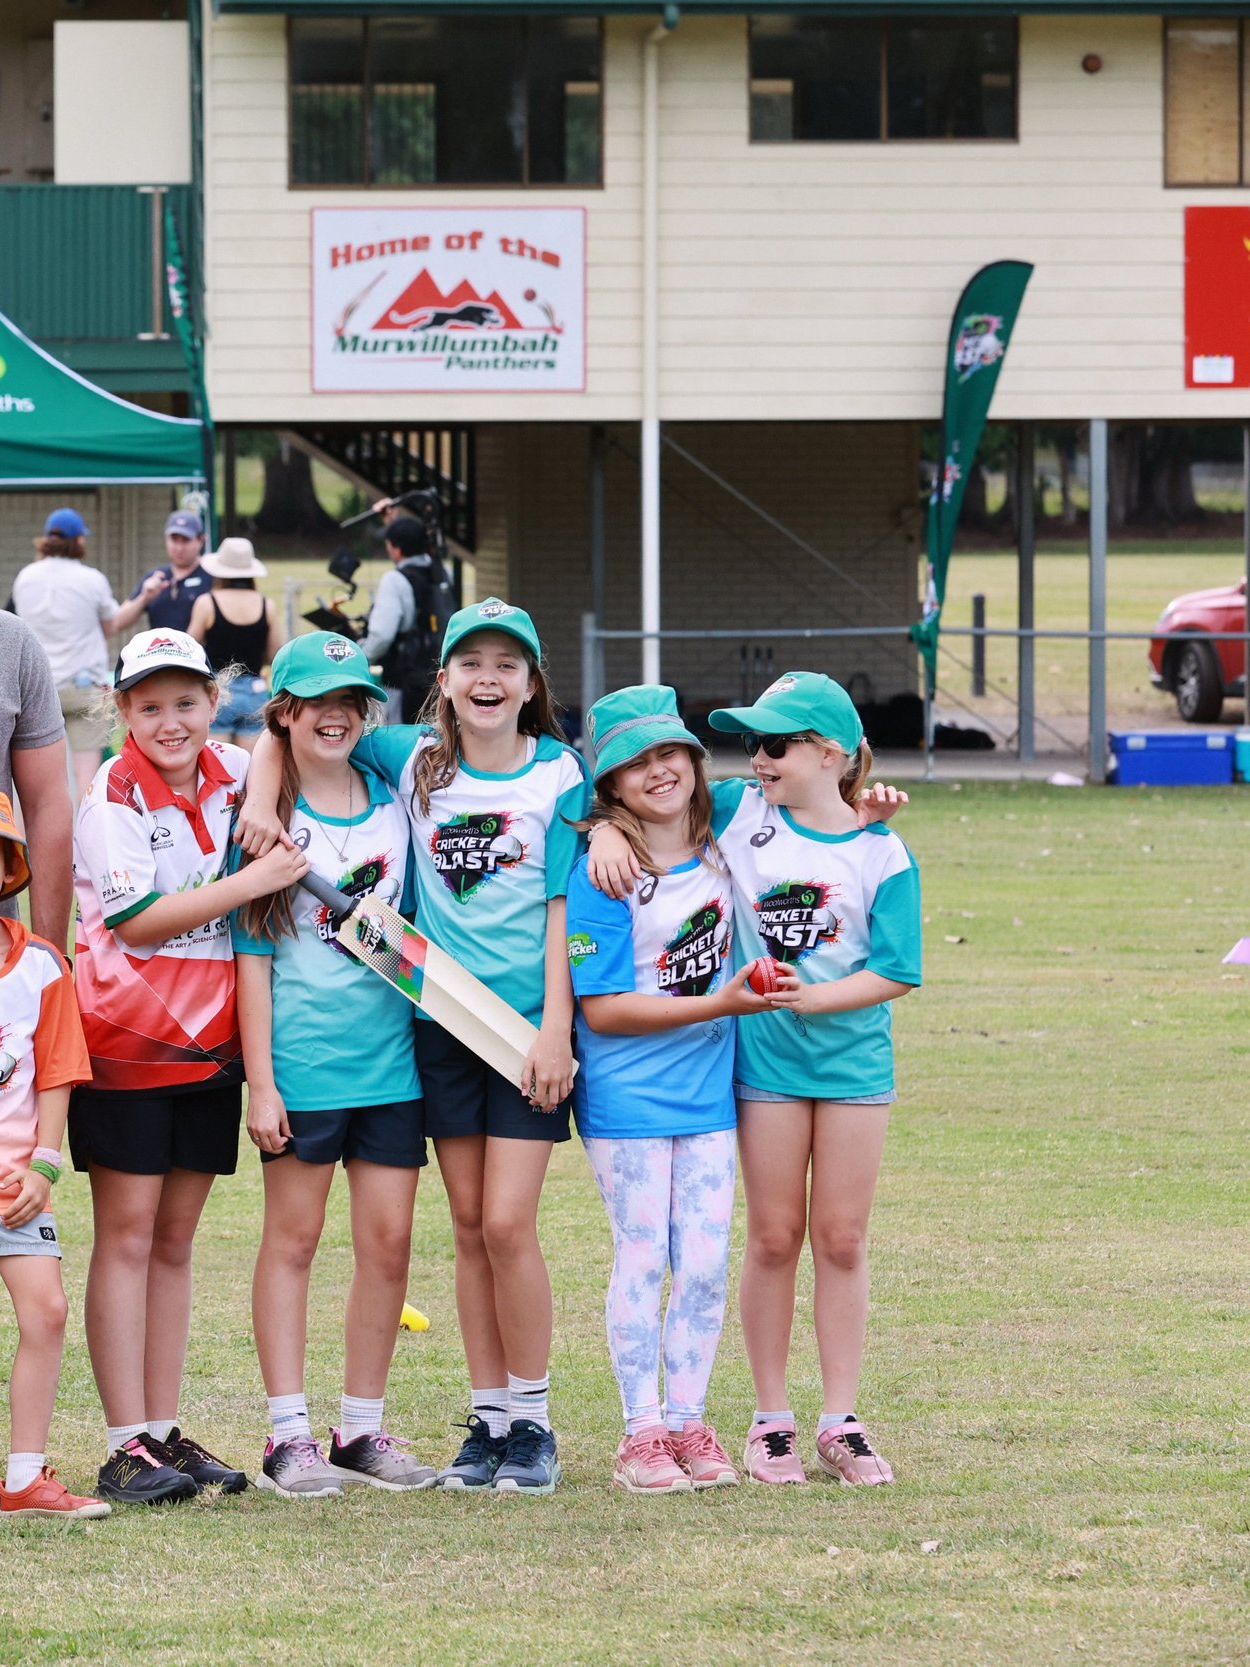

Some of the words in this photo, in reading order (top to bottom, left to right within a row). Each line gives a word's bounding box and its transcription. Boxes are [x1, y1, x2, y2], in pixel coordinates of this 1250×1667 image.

[330, 235, 431, 269] Home
[444, 230, 484, 251] of
[499, 236, 561, 268] the
[332, 332, 559, 354] Murwillumbah
[443, 356, 557, 371] Panthers
[435, 836, 492, 851] CRICKET
[665, 930, 714, 965] CRICKET
[658, 942, 723, 988] BLAST
